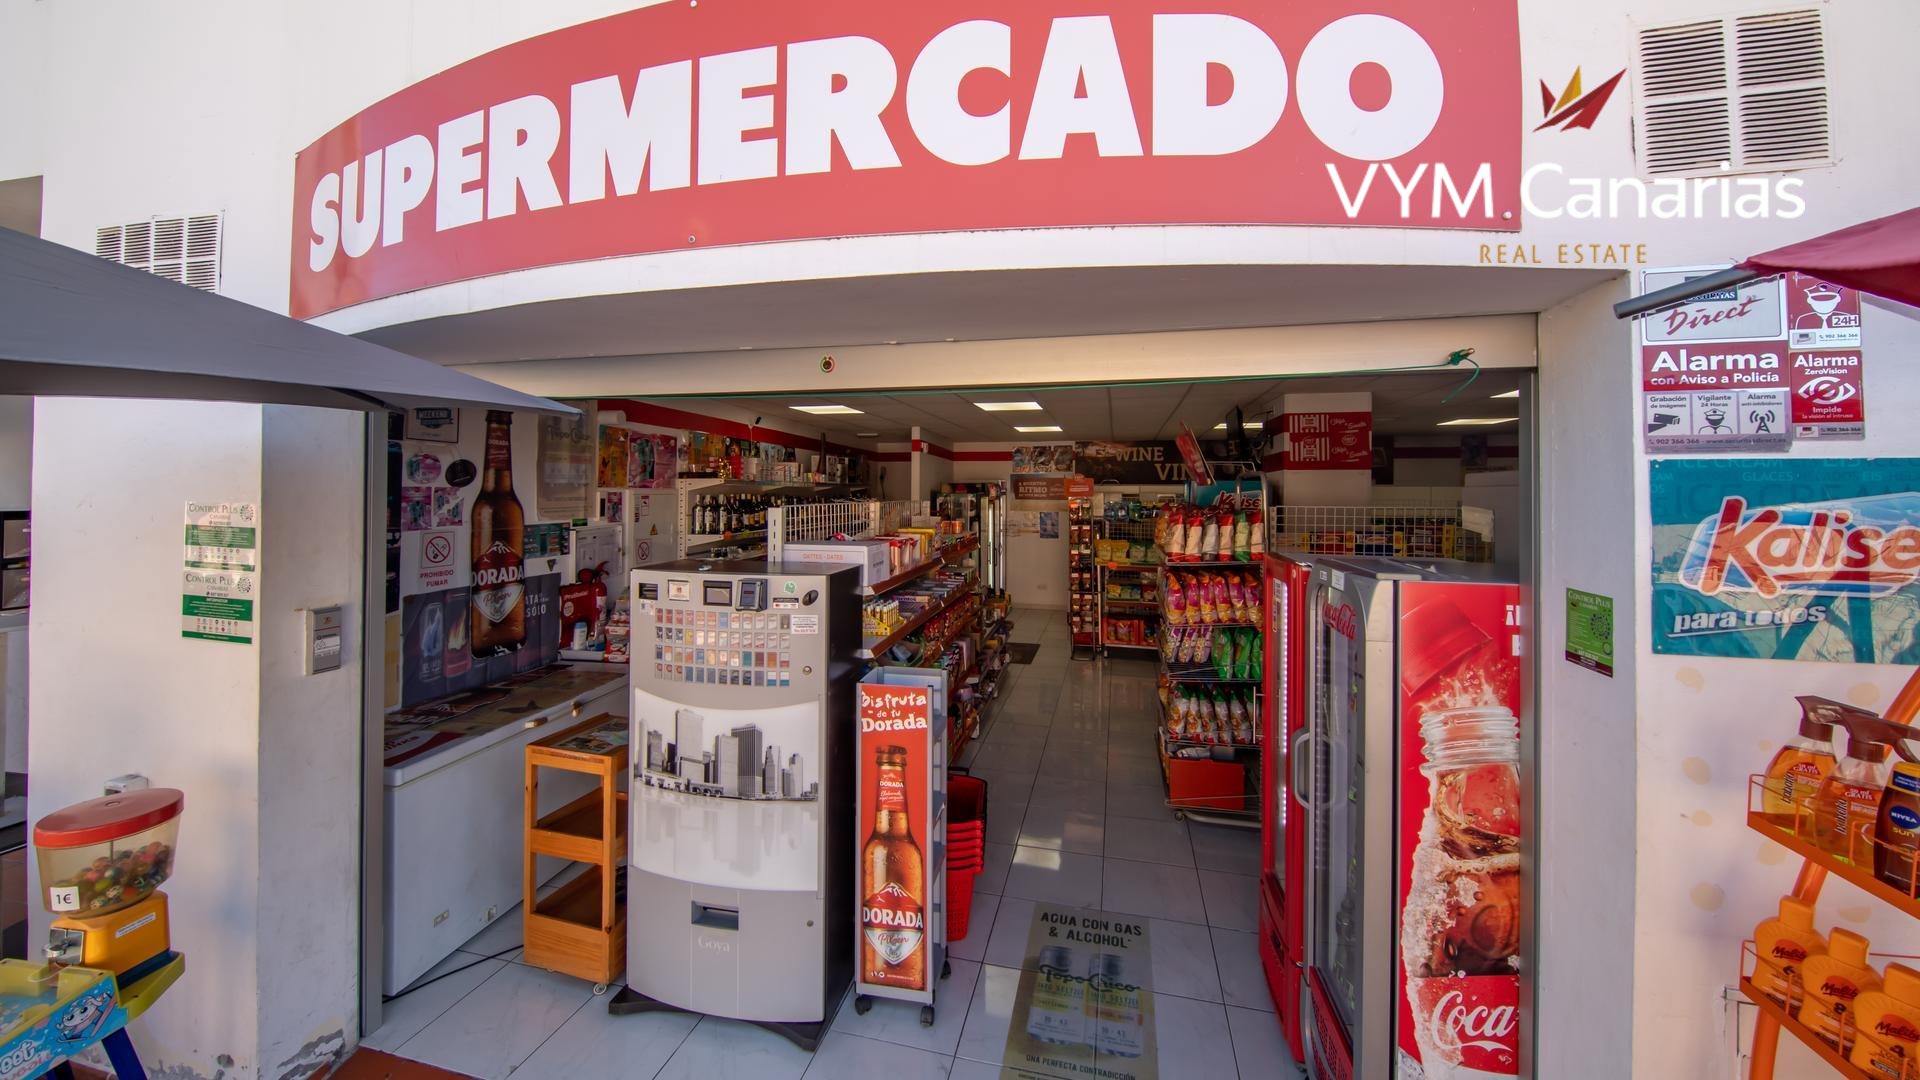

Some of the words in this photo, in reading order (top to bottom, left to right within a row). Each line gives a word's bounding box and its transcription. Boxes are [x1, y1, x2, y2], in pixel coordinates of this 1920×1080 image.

[309, 13, 1444, 272] SUPERMERCADO
[1664, 296, 1766, 336] Direct
[1833, 316, 1858, 326] 24H
[1651, 349, 1779, 373] Alarma
[1794, 354, 1858, 368] Alarma
[1651, 376, 1675, 386] con
[1678, 373, 1717, 385] Aviso
[1721, 375, 1730, 384] a
[1733, 371, 1780, 384] Policía
[1804, 368, 1848, 376] ZeroVision
[1650, 395, 1687, 403] Grabación
[1697, 394, 1732, 403] Vigilante
[1812, 406, 1842, 414] Impide
[1116, 447, 1164, 462] WINE
[1699, 497, 1920, 595] Kalise
[420, 570, 454, 579] PROHIBIDO
[472, 565, 525, 587] DORADA
[426, 579, 448, 587] FUMAR
[1673, 611, 1737, 634] para
[1745, 604, 1827, 627] todos
[862, 691, 927, 710] Disfruta
[877, 709, 888, 718] de
[862, 713, 928, 733] Dorada
[1793, 765, 1818, 775] GRATIS
[1844, 790, 1873, 800] GRATIS
[1891, 811, 1918, 824] NIVEA
[56, 892, 72, 905] 1€
[863, 906, 924, 929] DORADA
[1040, 912, 1077, 927] AGUA
[1082, 918, 1109, 932] CON
[1114, 922, 1142, 937] GAS
[1049, 926, 1058, 938] &
[1771, 946, 1808, 960] Malib
[1820, 982, 1859, 999] Malib
[1026, 1055, 1040, 1064] UNA
[1043, 1058, 1077, 1072] PERFECTA
